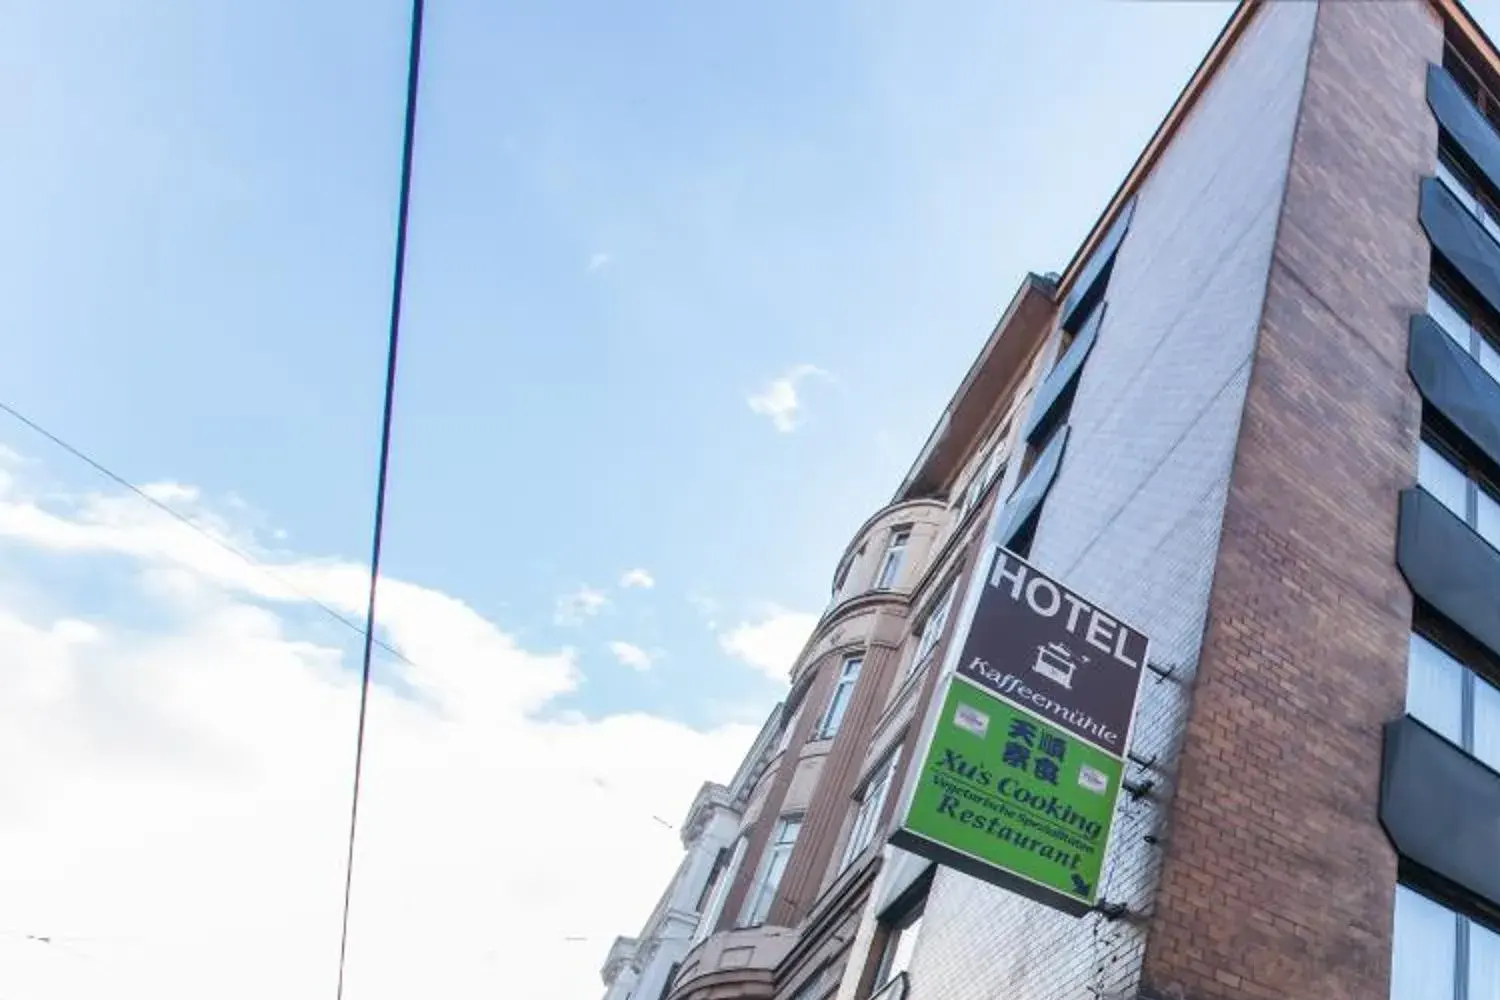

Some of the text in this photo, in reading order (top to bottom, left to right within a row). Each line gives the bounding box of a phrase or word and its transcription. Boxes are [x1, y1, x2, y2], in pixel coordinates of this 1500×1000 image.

[990, 554, 1138, 669] HOTEL
[969, 656, 1119, 746] Kaffeemühle
[936, 748, 1103, 841] Xu's Cooking
[936, 794, 1083, 870] Restaurant
